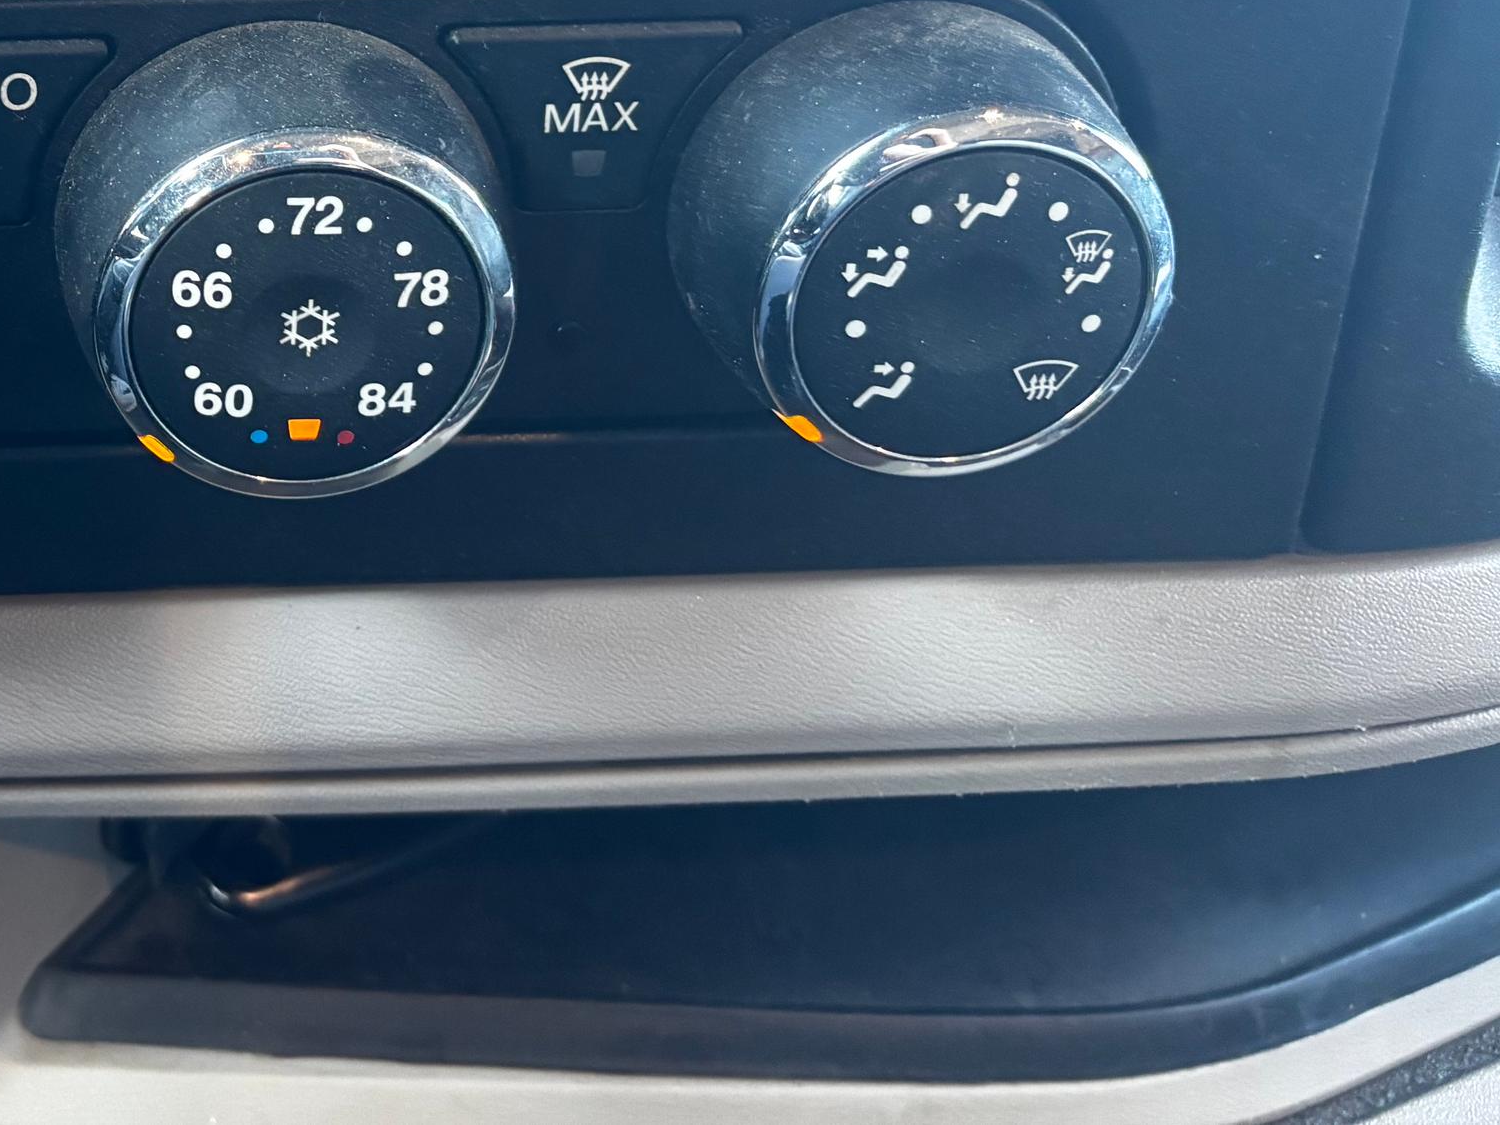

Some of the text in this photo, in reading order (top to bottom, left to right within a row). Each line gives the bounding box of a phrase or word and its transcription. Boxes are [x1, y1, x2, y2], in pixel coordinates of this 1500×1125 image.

[542, 101, 640, 134] MAX
[286, 195, 344, 236] 72
[171, 270, 233, 309] 66
[393, 269, 450, 308] 78
[193, 382, 254, 418] 60
[357, 382, 417, 416] 84
